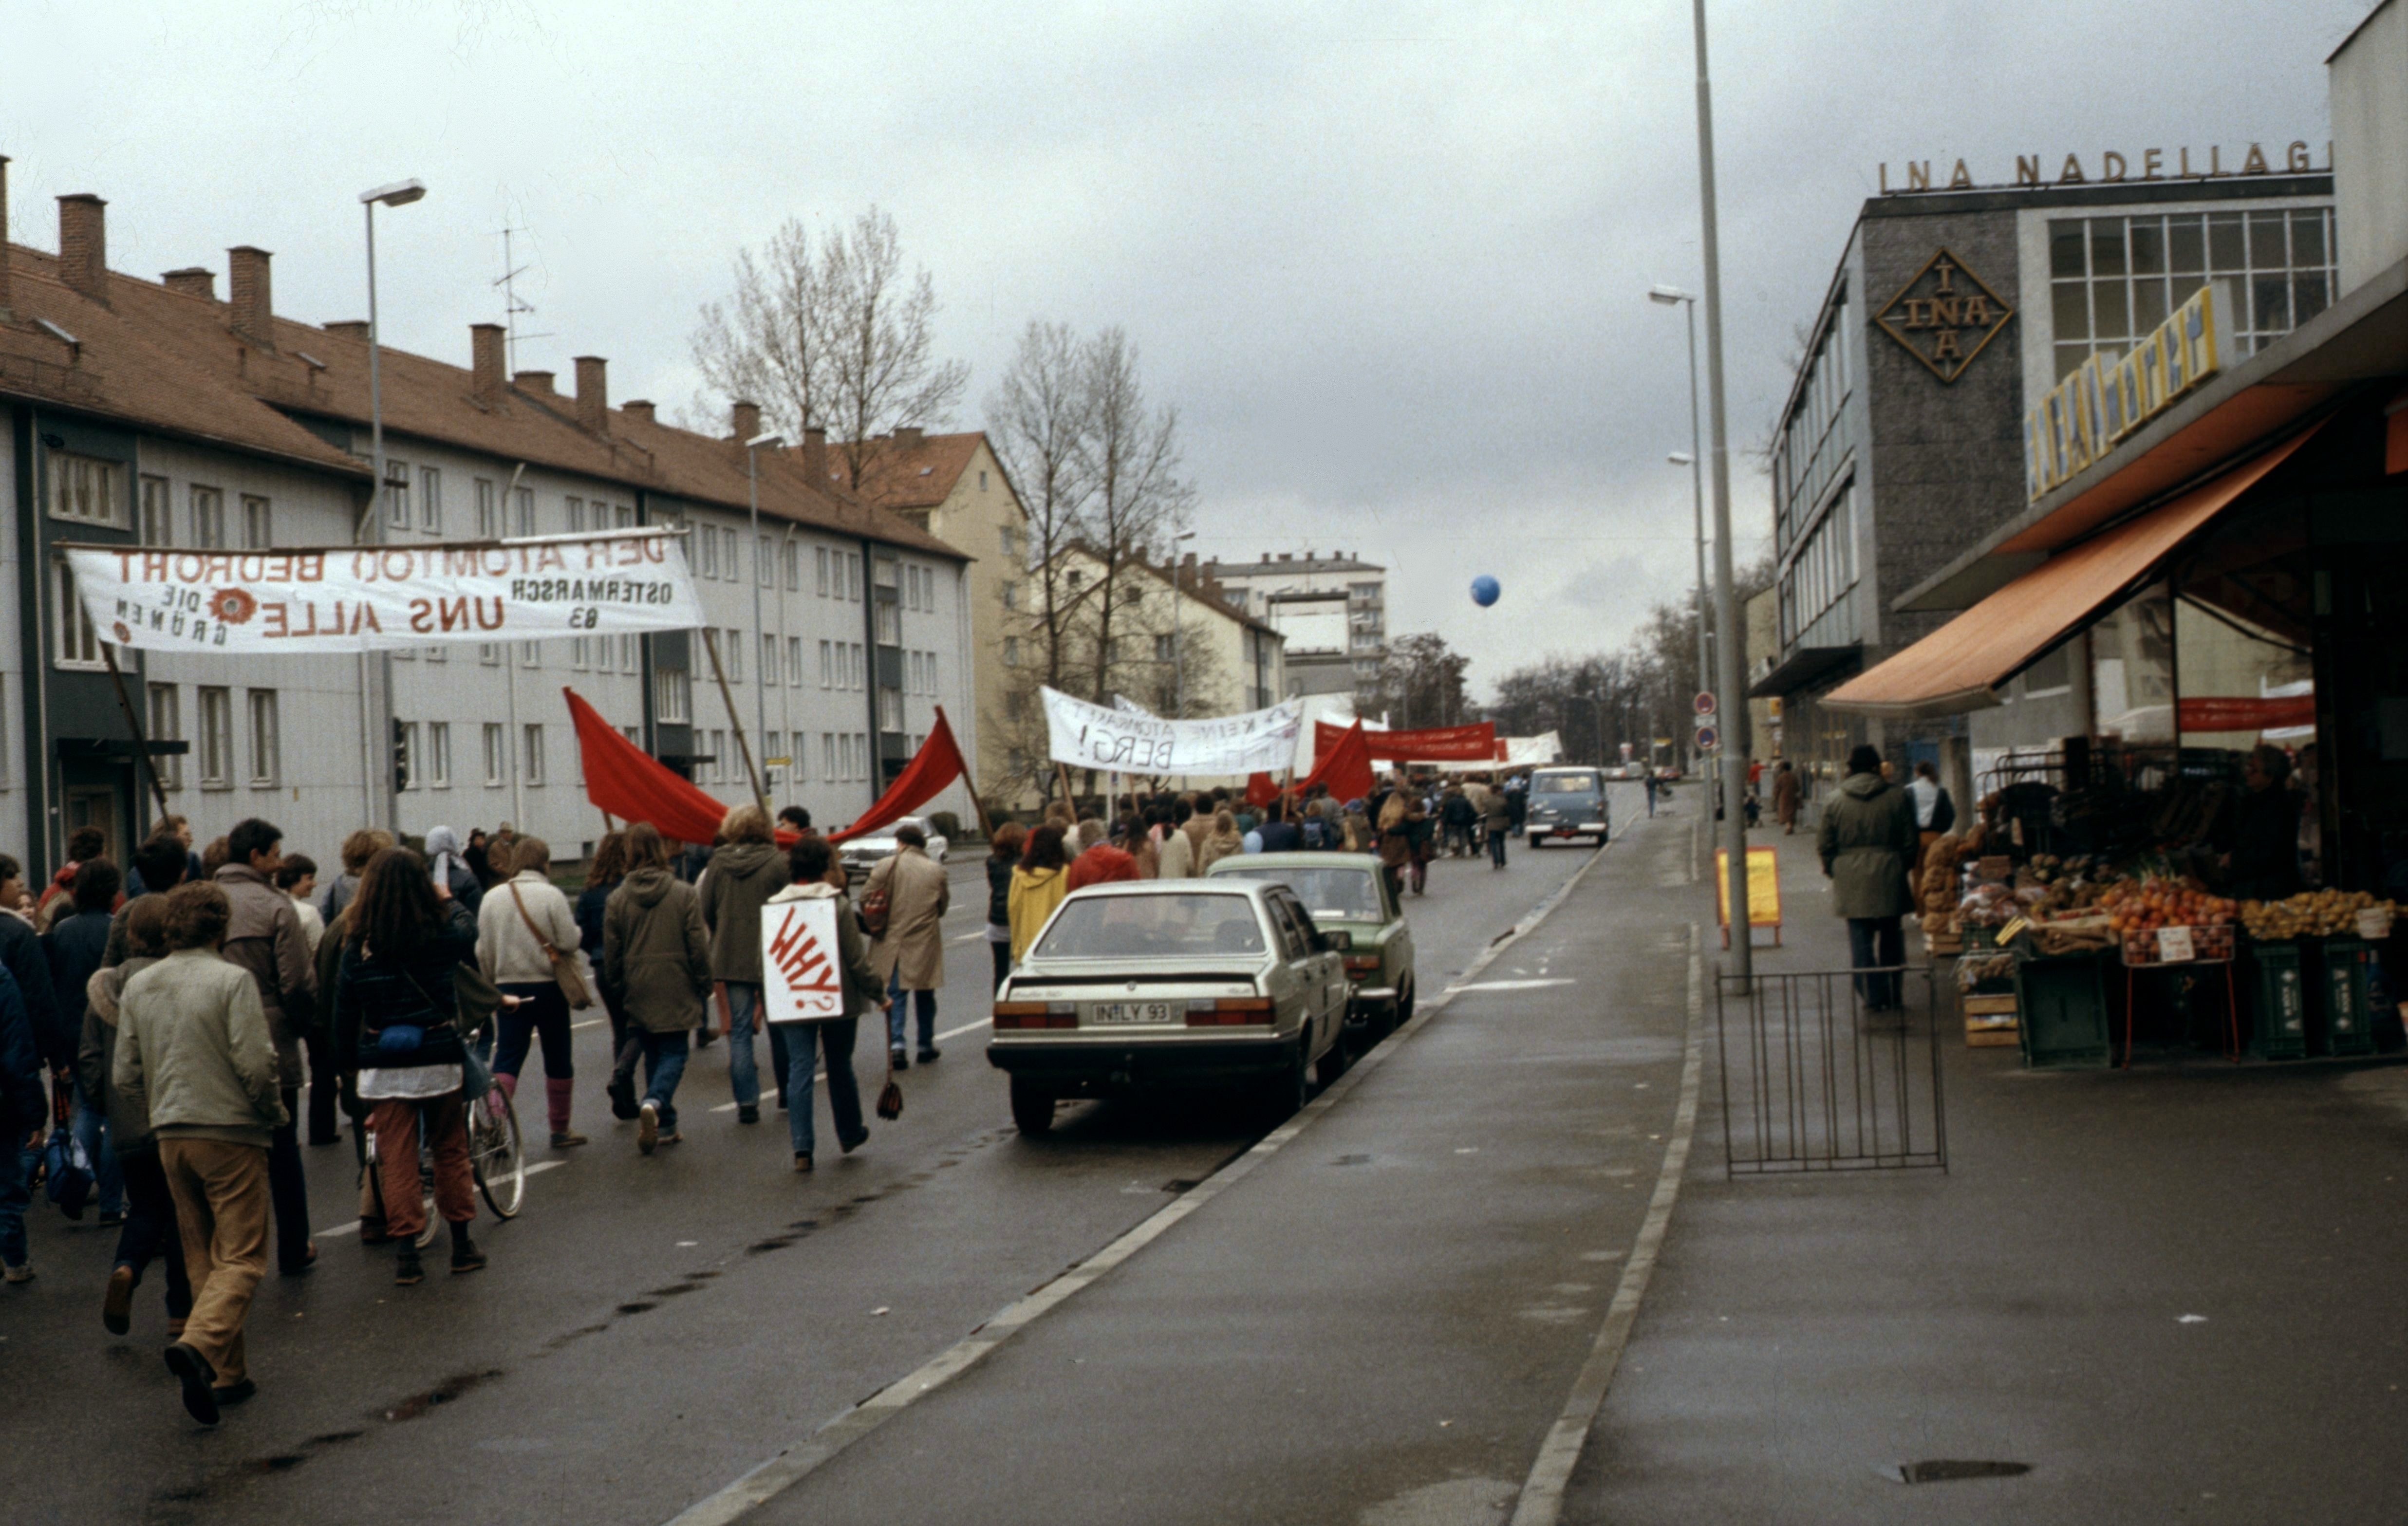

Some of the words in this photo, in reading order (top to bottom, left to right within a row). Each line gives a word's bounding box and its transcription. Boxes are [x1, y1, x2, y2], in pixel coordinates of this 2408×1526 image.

[1879, 158, 1973, 194] INA
[2017, 140, 2333, 185] NADELLAG
[1902, 296, 1990, 329] INA
[1121, 1005, 1141, 1021] LY
[1148, 1005, 1167, 1020] 93
